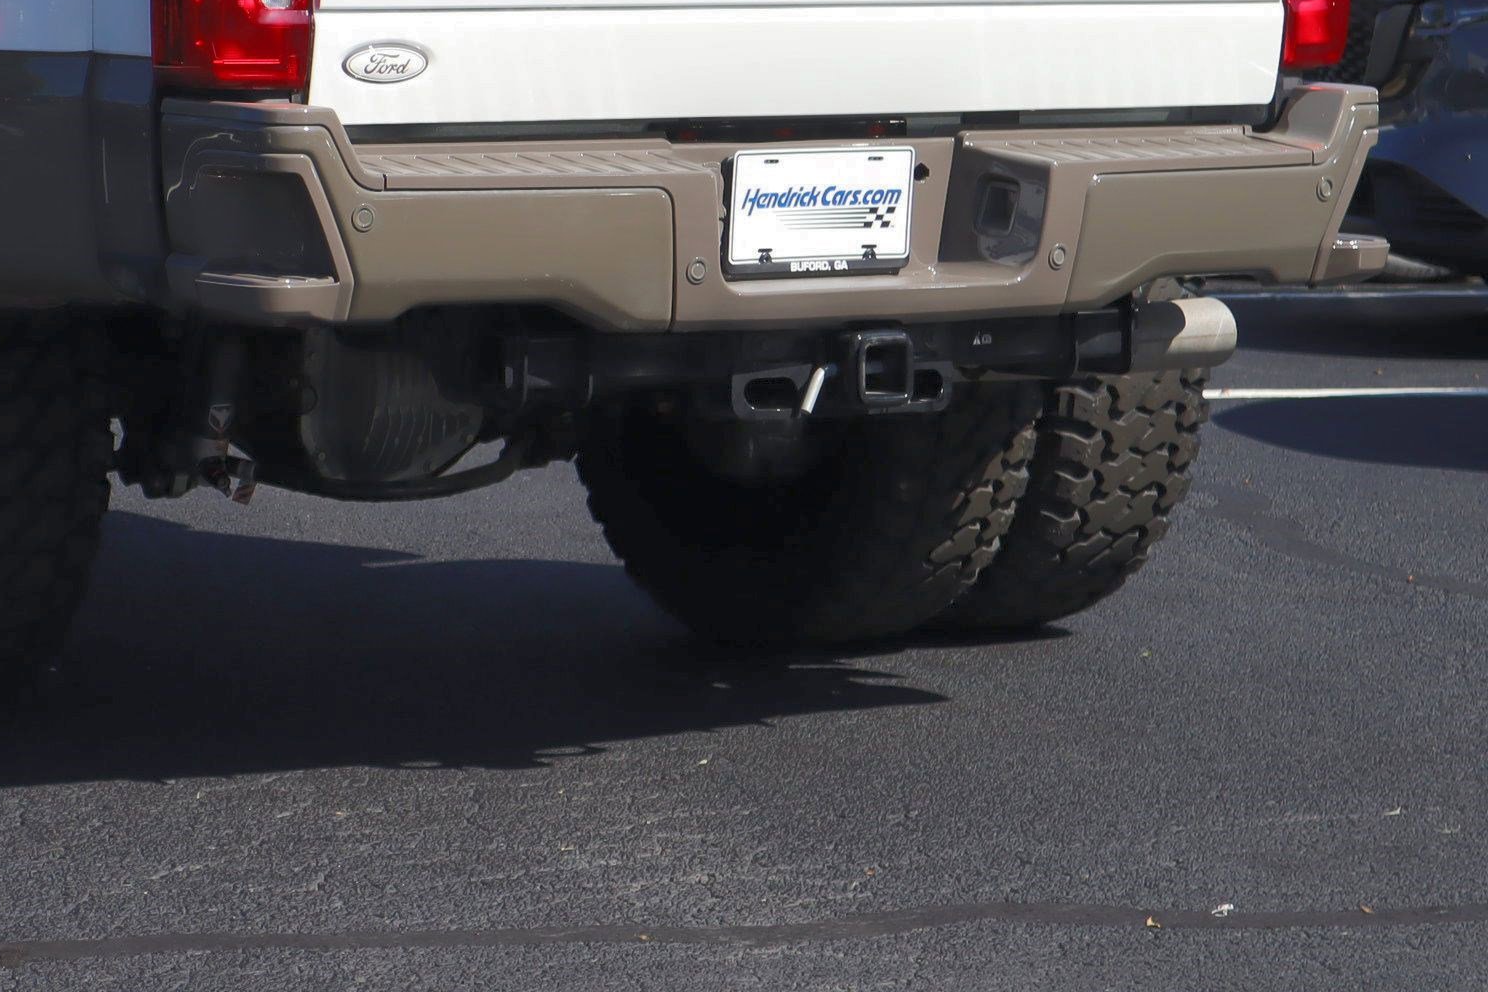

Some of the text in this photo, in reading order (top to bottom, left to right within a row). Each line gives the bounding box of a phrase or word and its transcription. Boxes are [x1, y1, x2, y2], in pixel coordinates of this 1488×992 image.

[363, 52, 411, 75] Ford
[790, 260, 848, 272] BUFORD, GA
